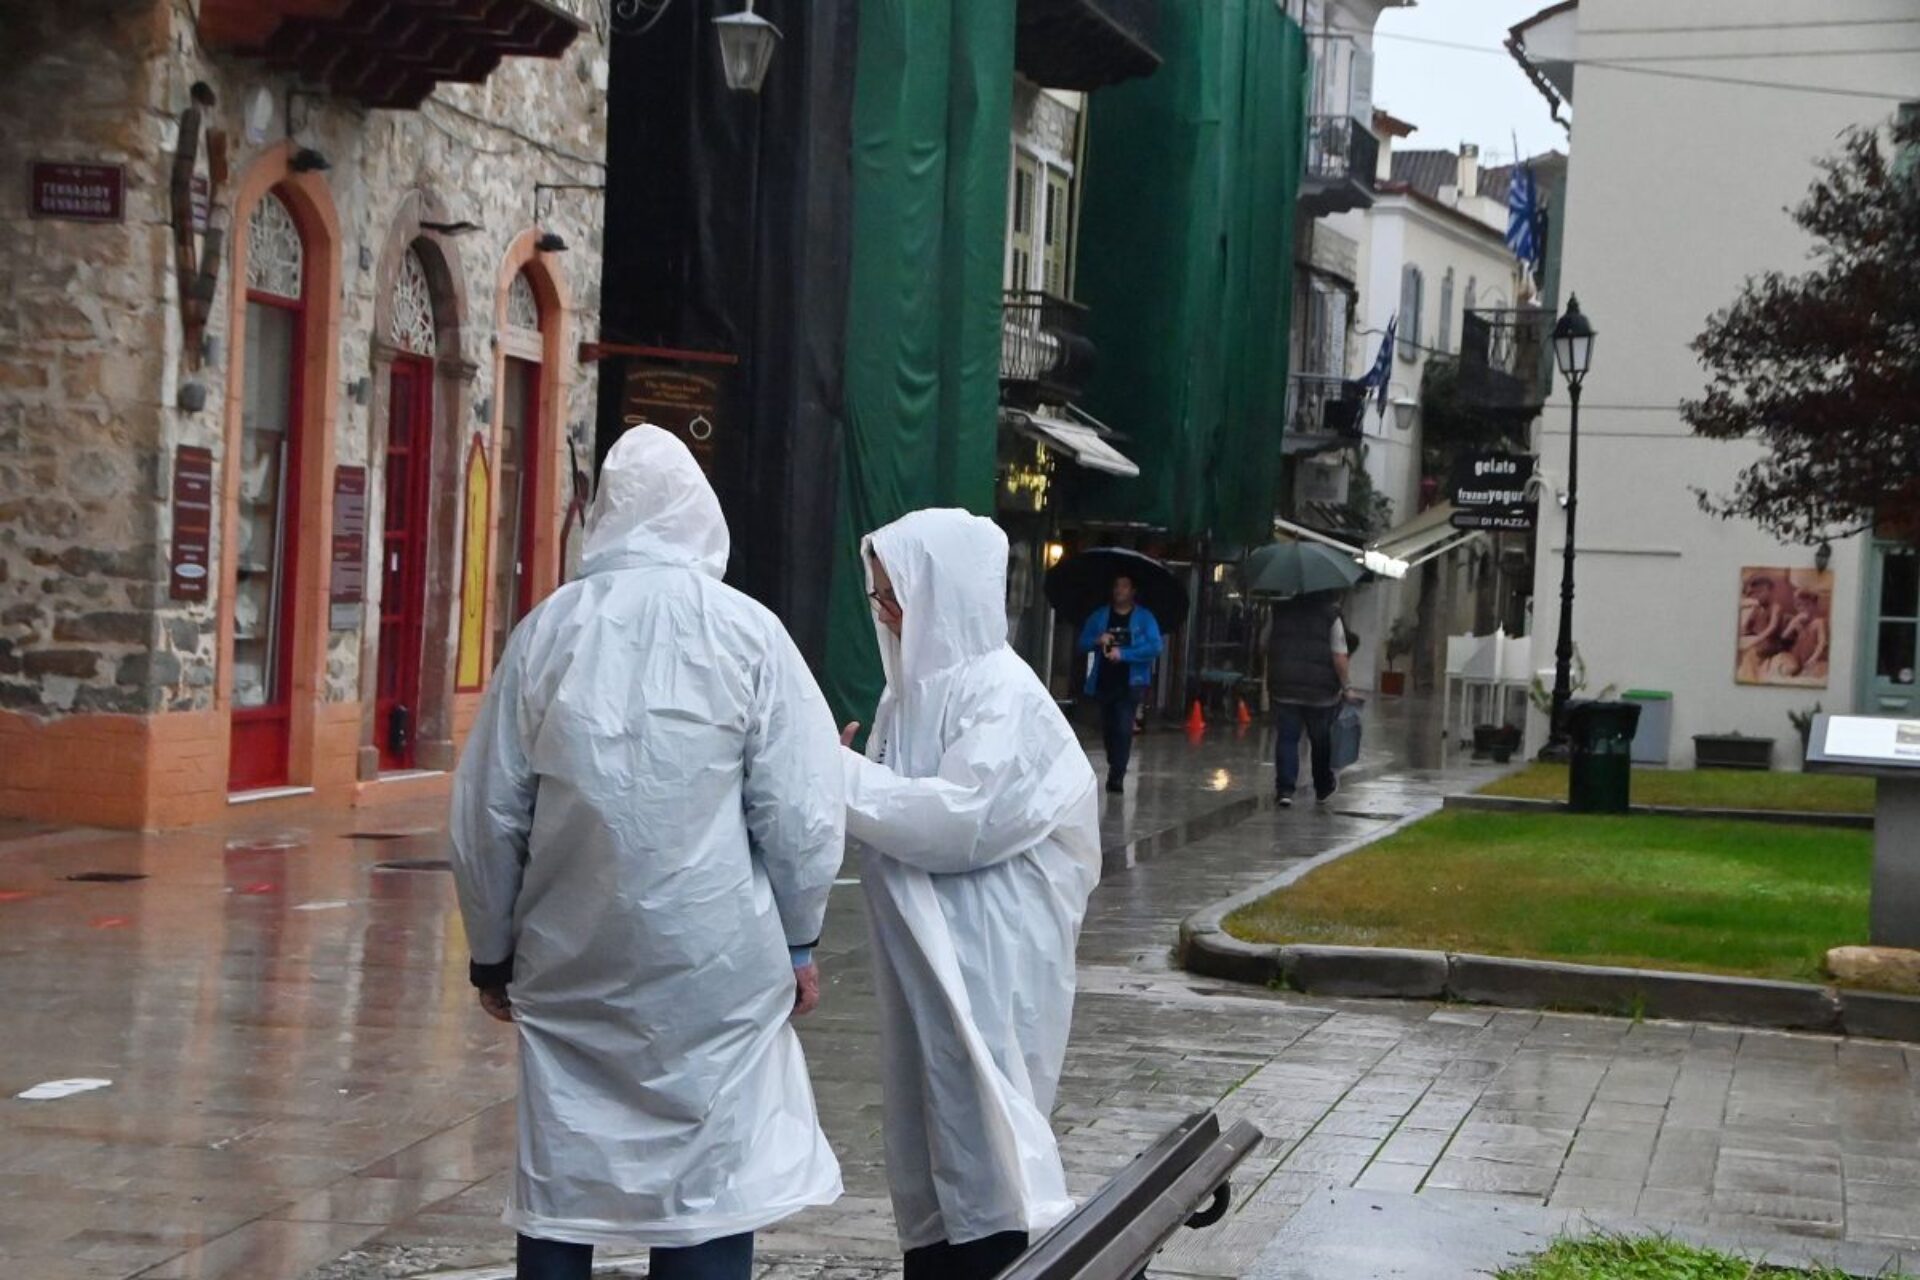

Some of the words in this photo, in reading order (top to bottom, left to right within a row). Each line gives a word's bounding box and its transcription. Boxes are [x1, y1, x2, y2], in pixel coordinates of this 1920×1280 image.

[1475, 457, 1517, 476] gelato
[1481, 517, 1492, 526] DI
[1494, 517, 1531, 527] PIAZZA
